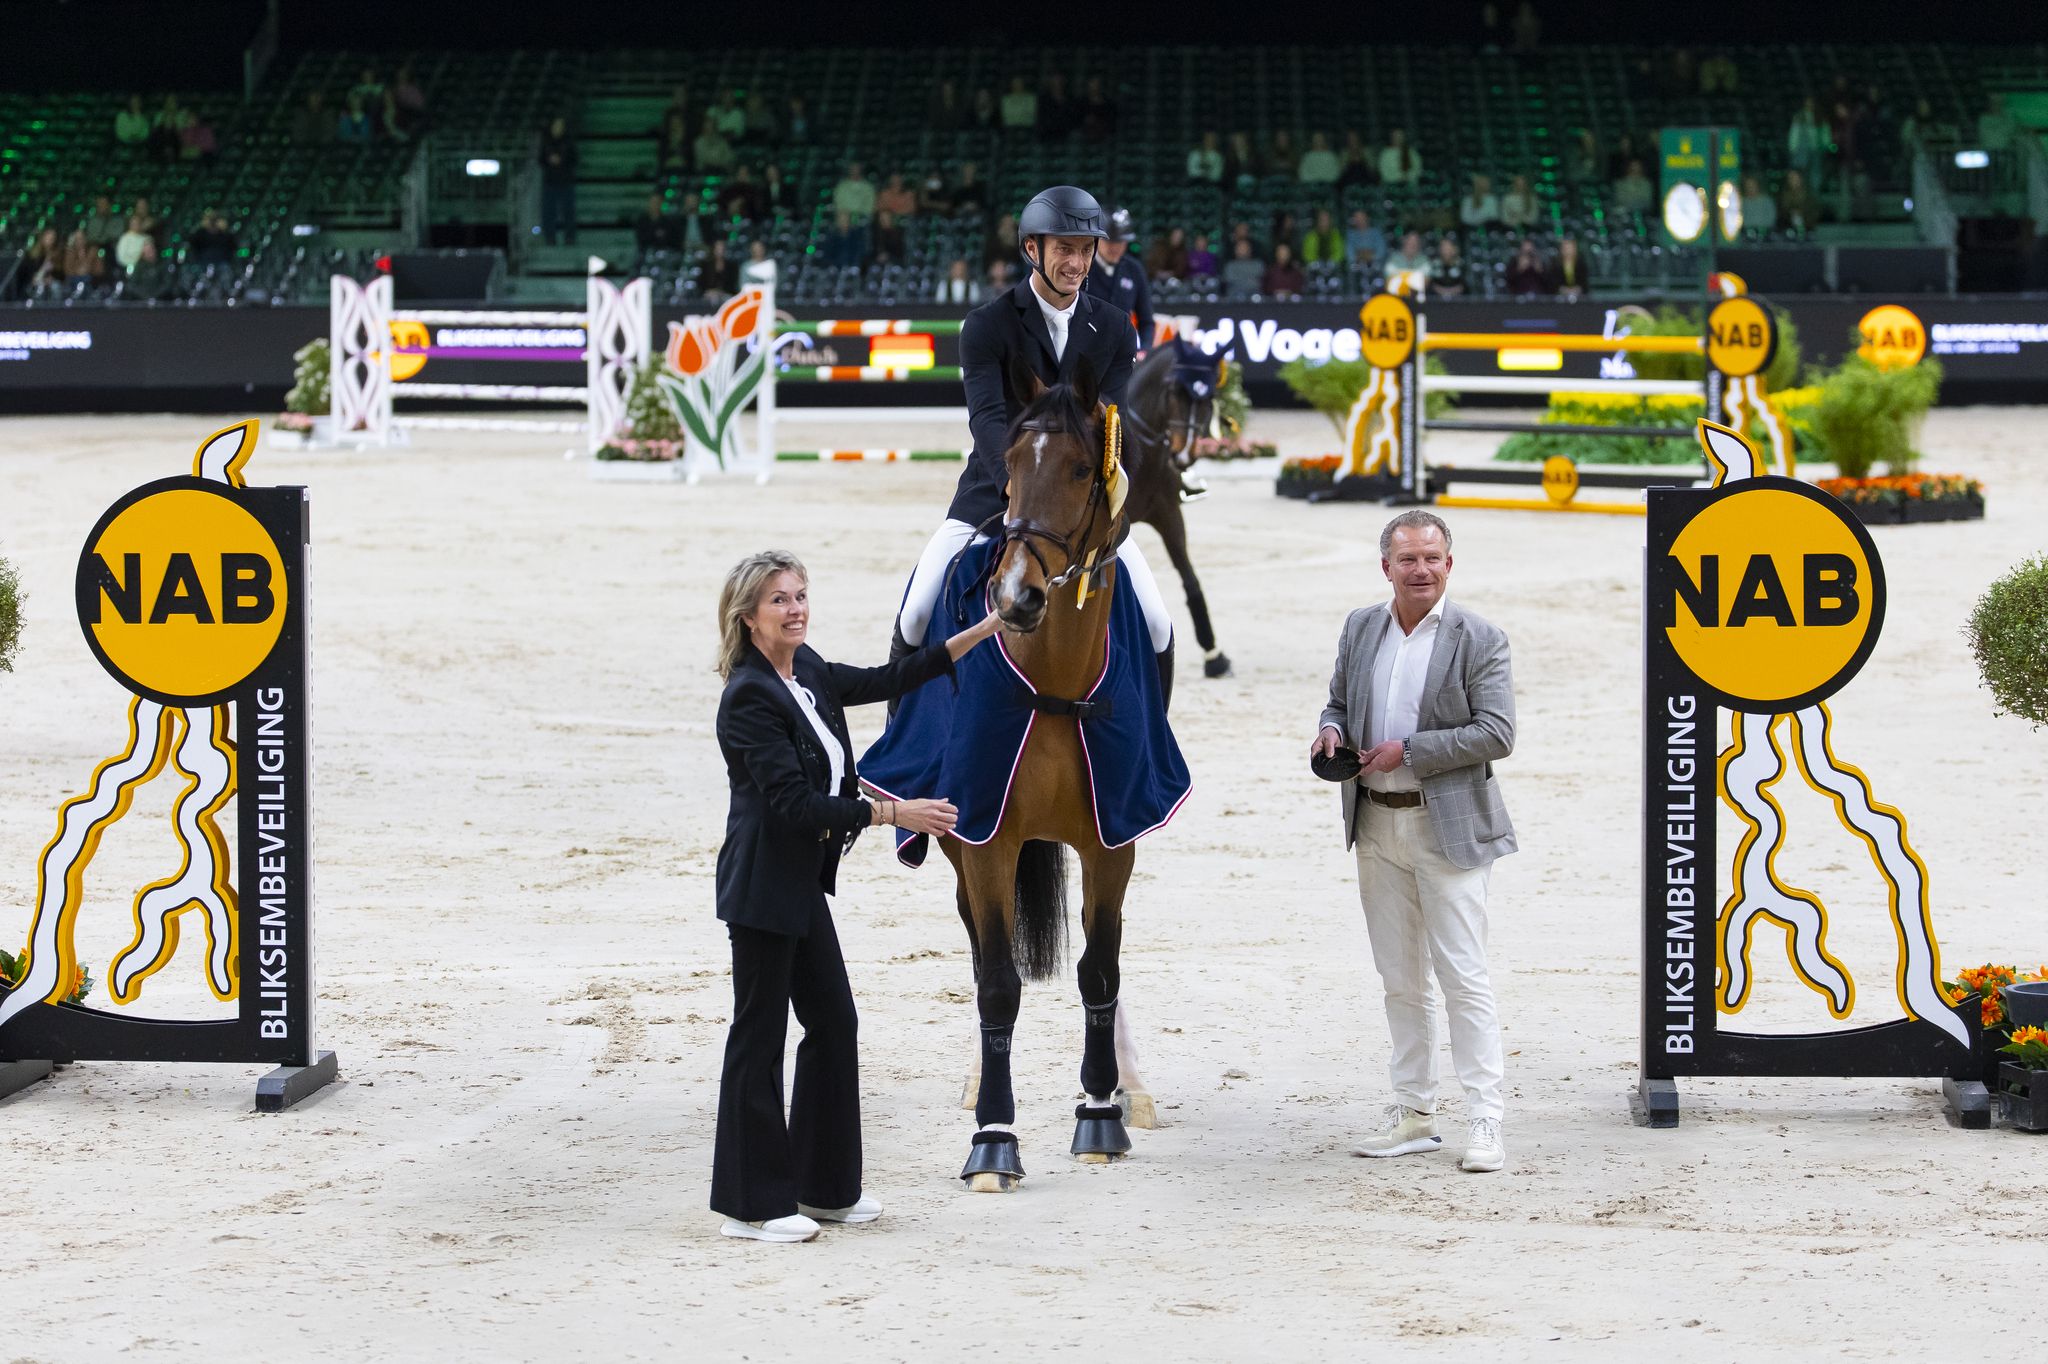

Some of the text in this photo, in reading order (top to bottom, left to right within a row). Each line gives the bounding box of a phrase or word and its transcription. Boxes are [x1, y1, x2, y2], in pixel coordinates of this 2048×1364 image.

[1711, 324, 1763, 348] NAB
[90, 552, 275, 625] NAB
[1667, 553, 1860, 628] NAB
[256, 687, 287, 1039] BLIKSEMBEVEILIGING
[1665, 695, 1696, 1054] BLIKSEMBEVEILIGING
